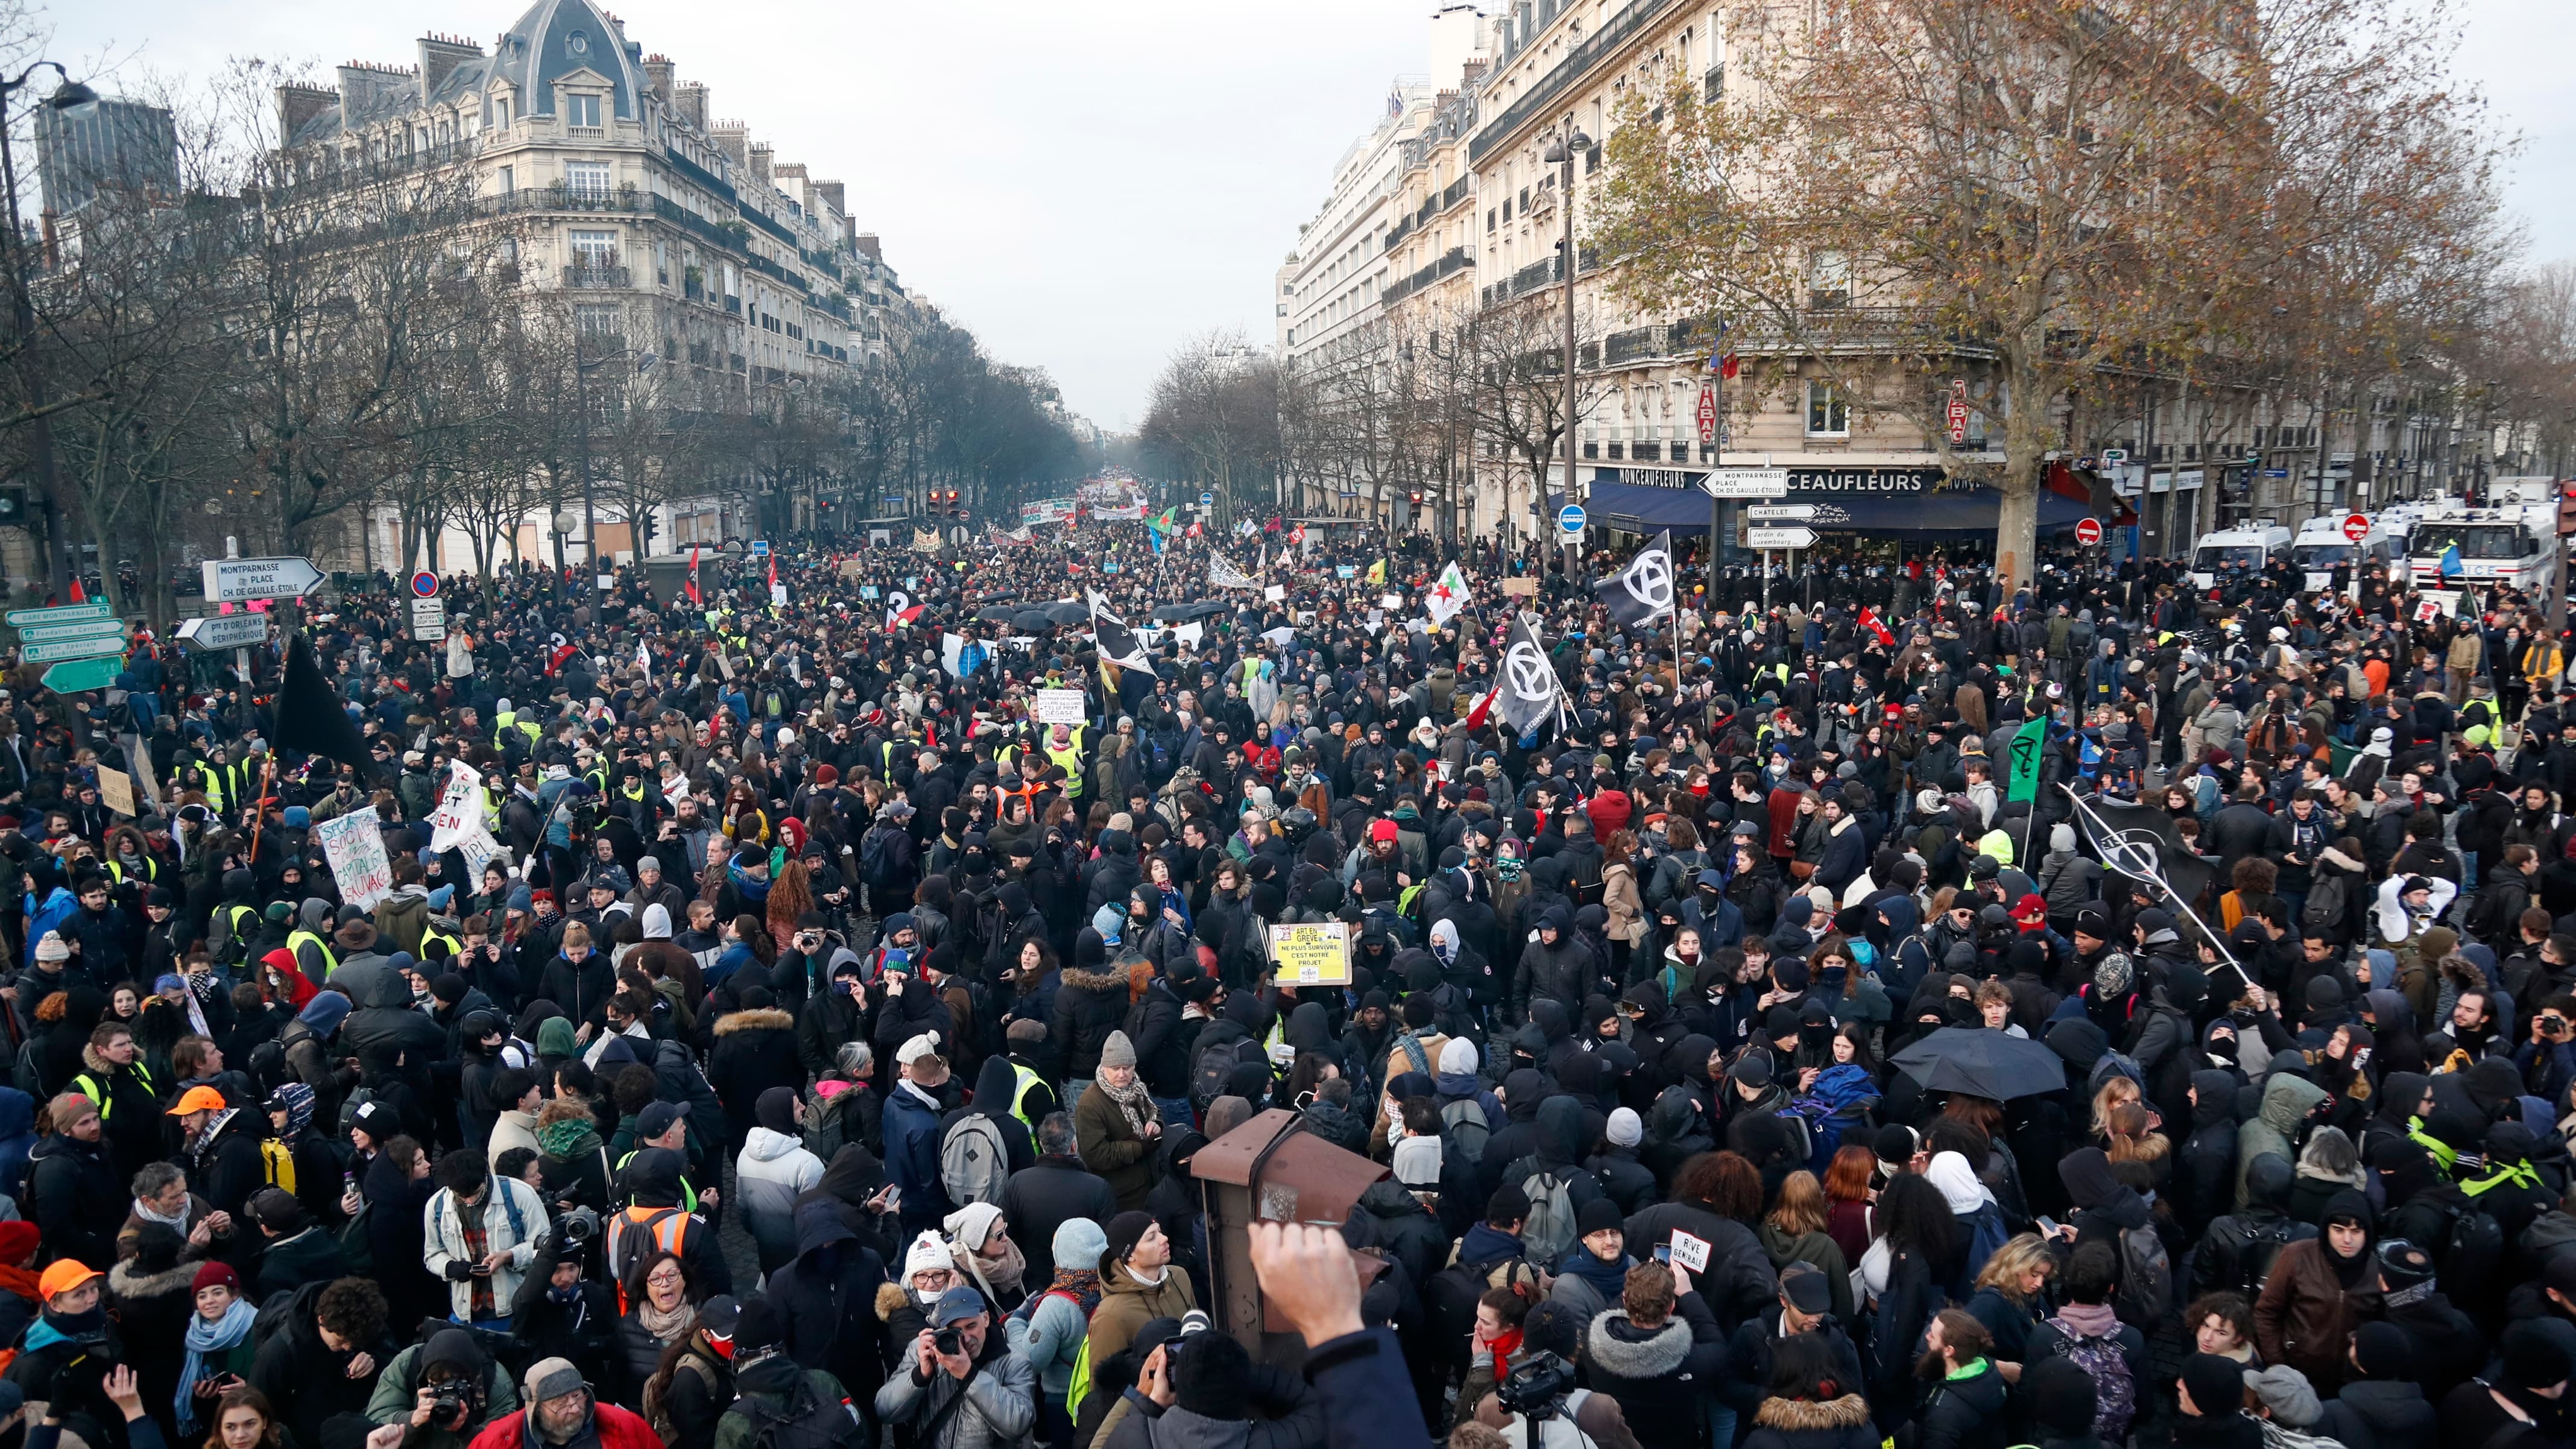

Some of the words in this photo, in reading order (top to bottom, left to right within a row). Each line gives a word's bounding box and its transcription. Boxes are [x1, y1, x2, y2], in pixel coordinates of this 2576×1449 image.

[1700, 386, 1714, 442] TABAC
[1950, 383, 1966, 441] TBAC
[1619, 469, 1685, 488] MONCEAUFLEURS
[1785, 474, 1922, 491] CEAUFLEURS
[221, 563, 279, 574] MONTPARNASSE
[2433, 566, 2495, 575] PICE
[251, 575, 273, 584] PLACE
[247, 584, 298, 595] GAULLE-ÉTOILE
[43, 608, 97, 619] MONTPARNASSE
[224, 617, 262, 630] D'ORLÉANS
[212, 630, 264, 643] PÉRIPHÉRIQUE
[346, 865, 390, 901] SAUVAGE
